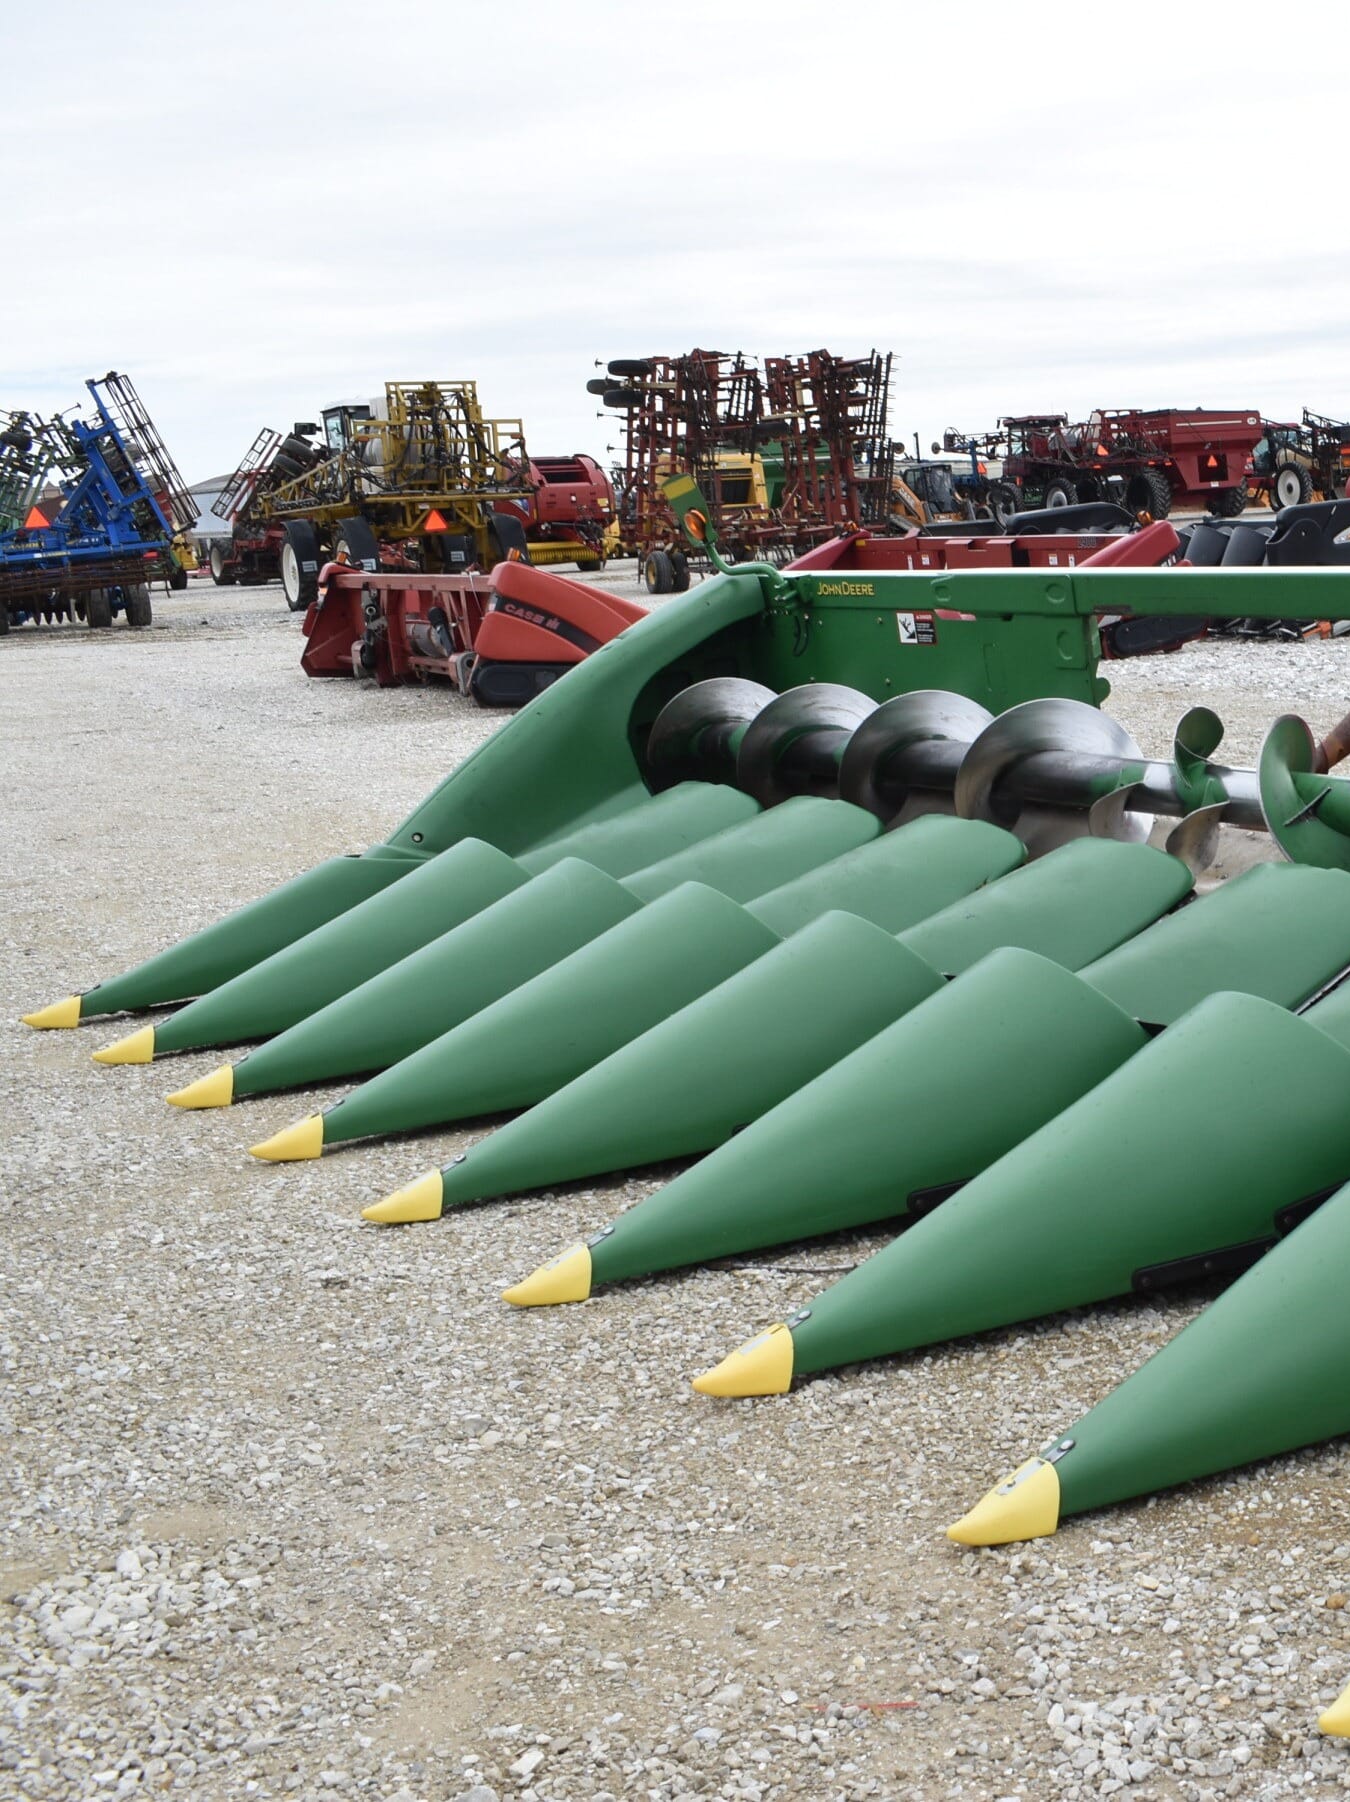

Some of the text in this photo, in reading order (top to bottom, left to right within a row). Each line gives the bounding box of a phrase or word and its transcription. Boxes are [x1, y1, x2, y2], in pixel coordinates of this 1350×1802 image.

[817, 581, 876, 596] JOHN DEERE
[504, 603, 545, 625] CASE
